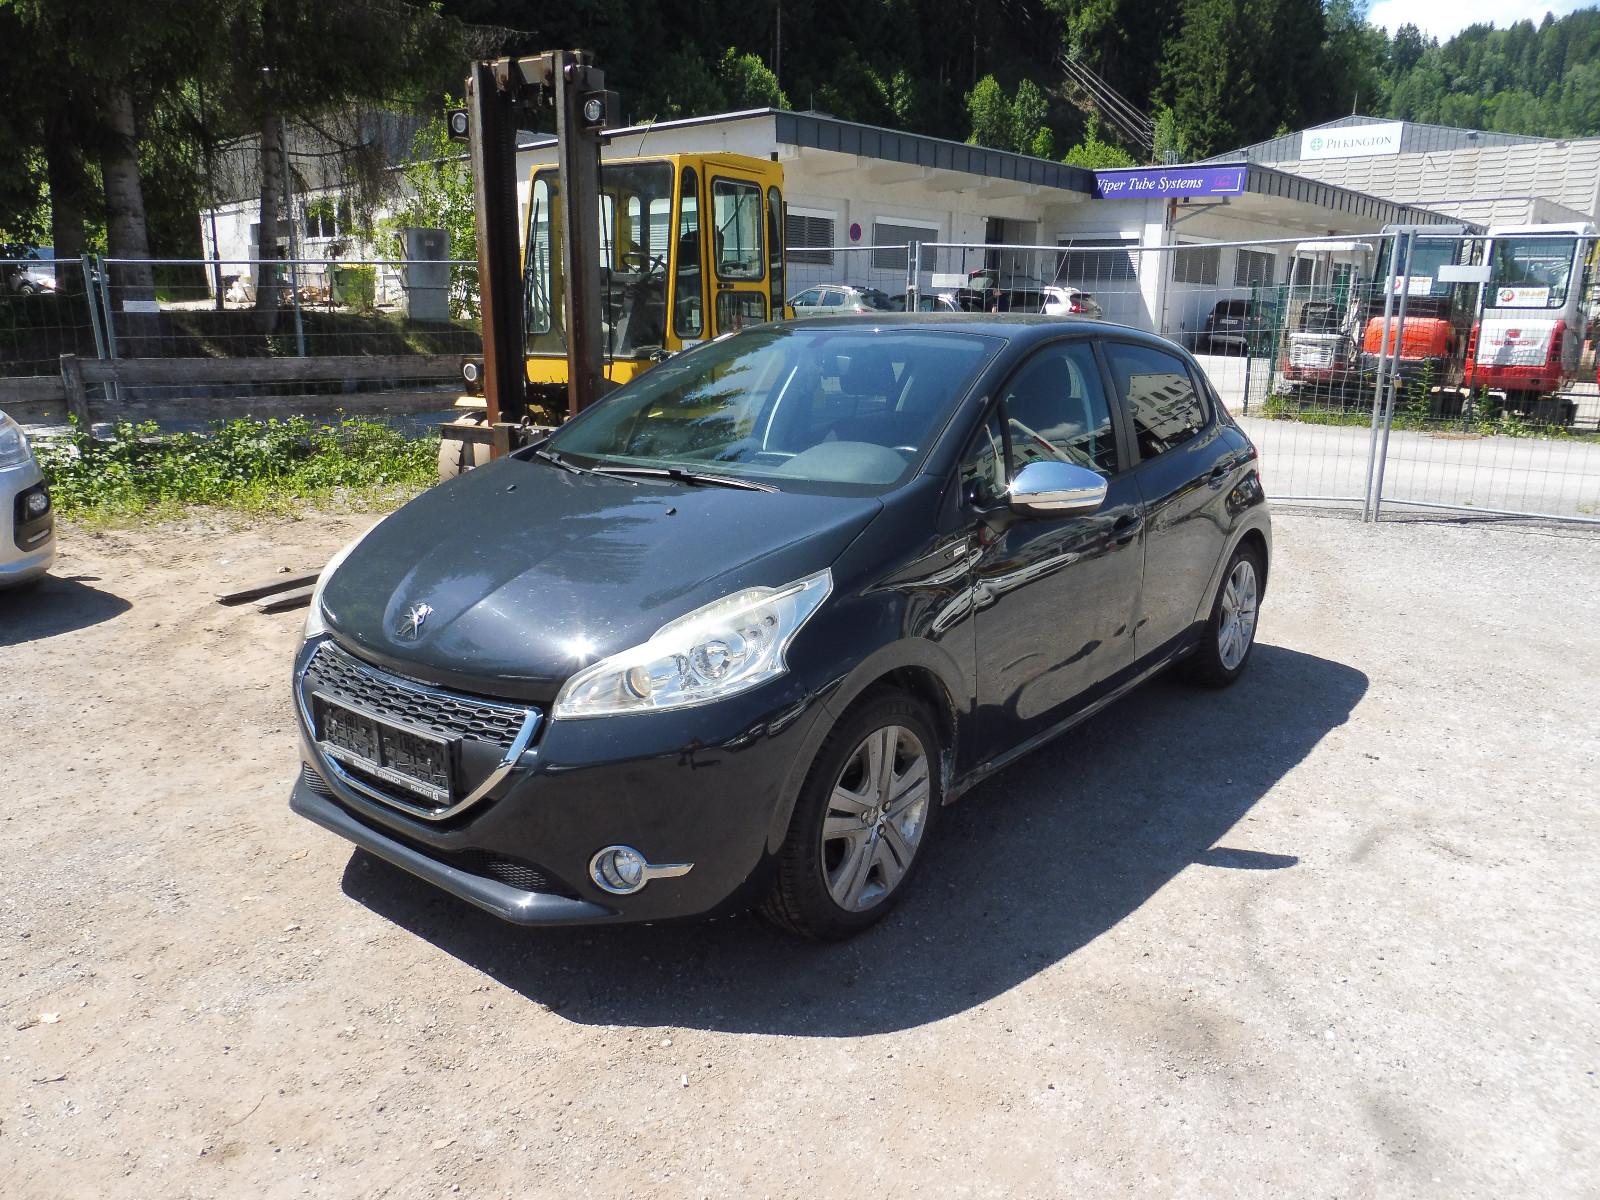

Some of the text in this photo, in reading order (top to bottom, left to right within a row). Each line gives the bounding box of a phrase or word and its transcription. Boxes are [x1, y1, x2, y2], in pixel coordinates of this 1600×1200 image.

[1326, 136, 1392, 149] PILKINGTON
[1097, 179, 1126, 194] Viper
[1129, 178, 1156, 190] Tube
[1158, 177, 1203, 192] Systems
